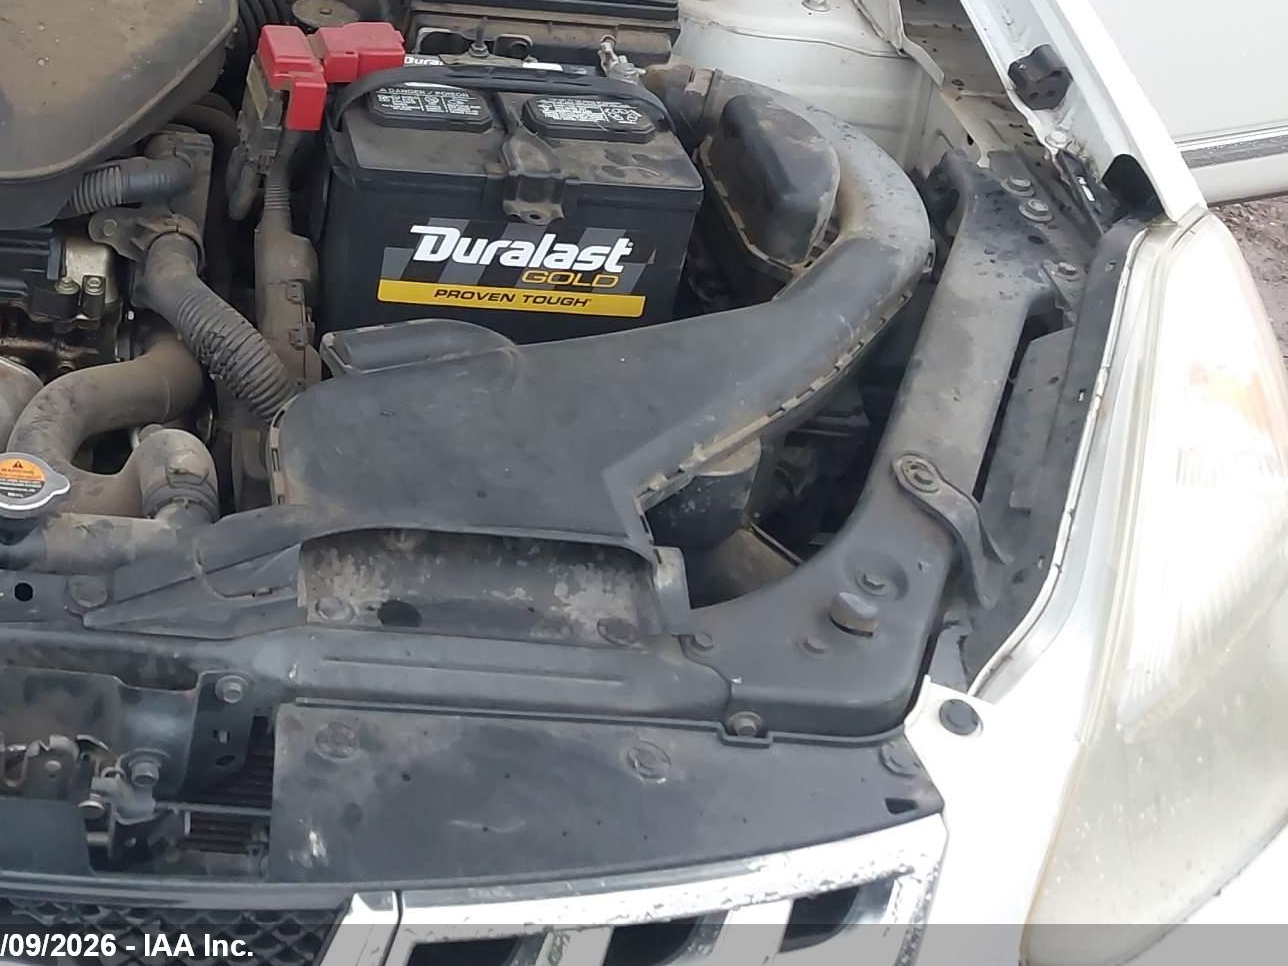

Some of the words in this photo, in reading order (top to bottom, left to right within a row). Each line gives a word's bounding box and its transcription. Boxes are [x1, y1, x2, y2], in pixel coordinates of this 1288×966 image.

[410, 225, 633, 273] Duralast
[521, 270, 619, 288] GOLD
[434, 289, 515, 303] PROVEN
[523, 294, 589, 308] TOUGH
